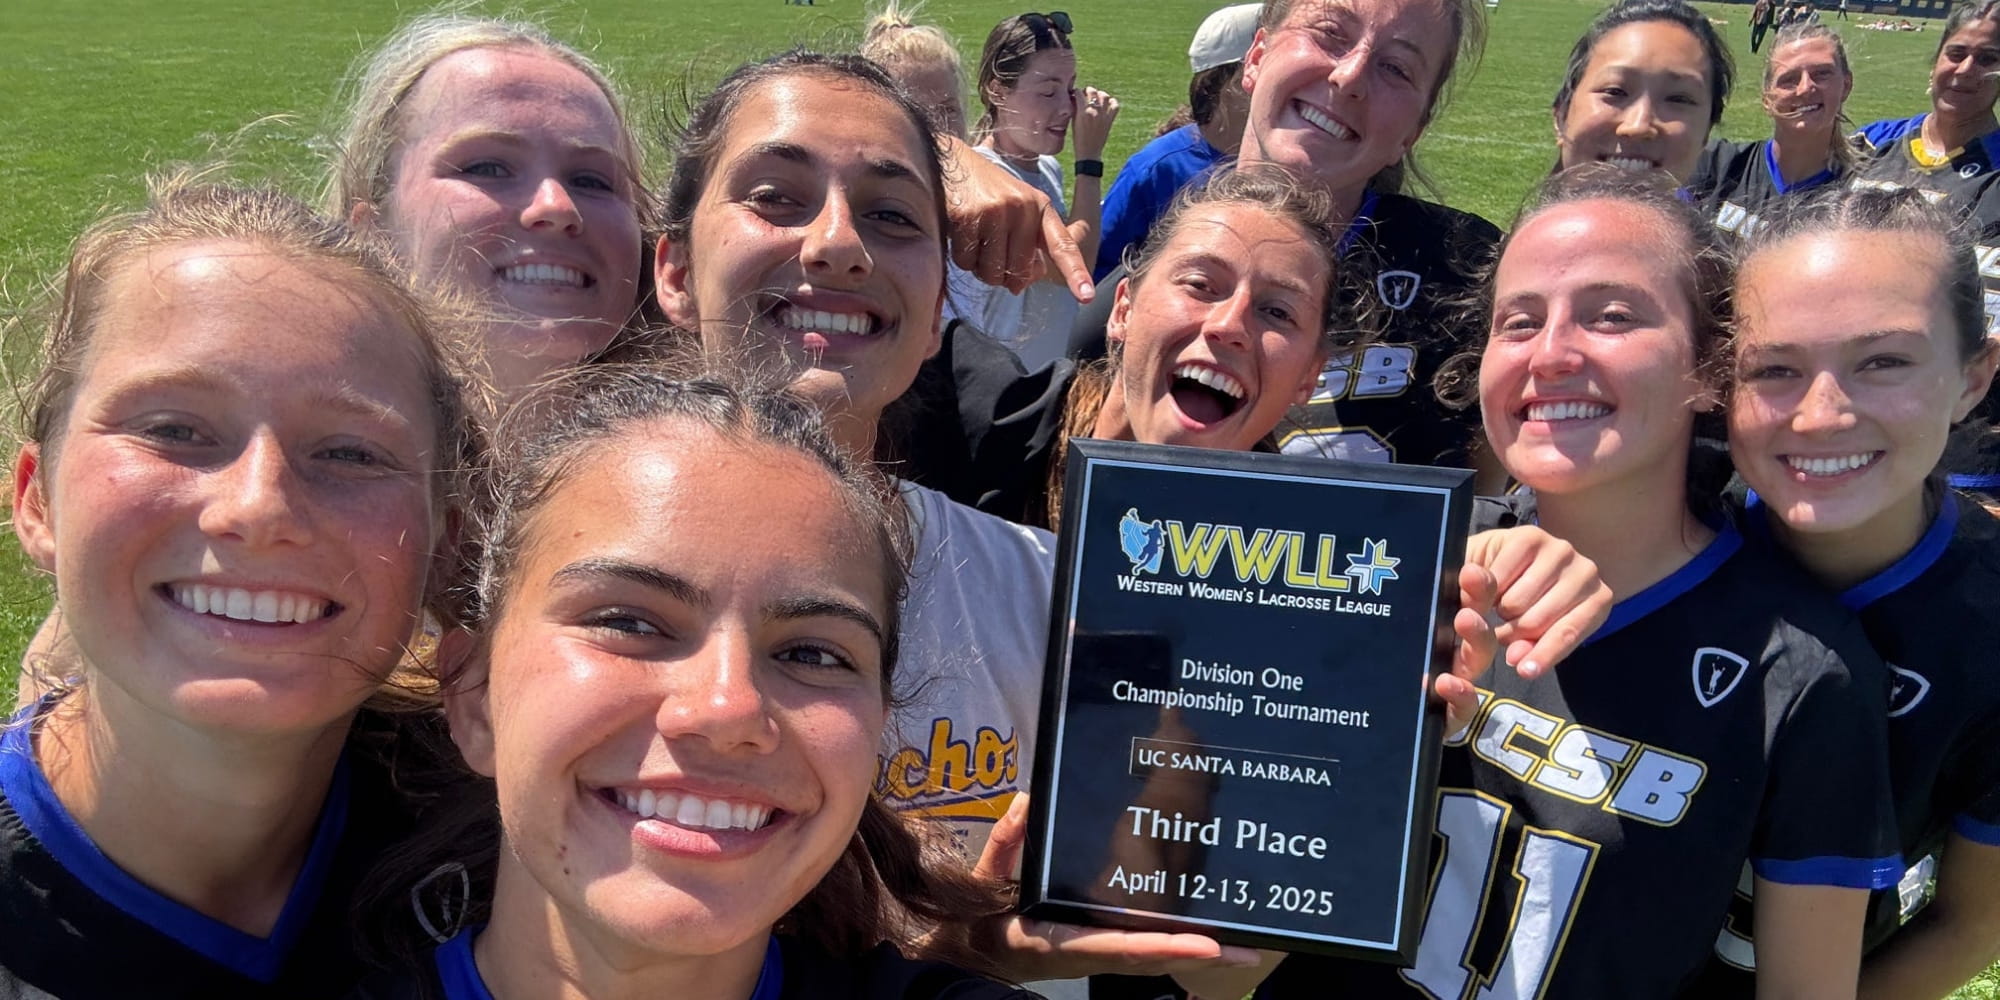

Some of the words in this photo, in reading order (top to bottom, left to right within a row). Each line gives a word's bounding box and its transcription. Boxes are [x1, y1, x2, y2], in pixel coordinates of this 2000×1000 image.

[1166, 520, 1350, 591] WWLL
[1181, 659, 1254, 687] Division
[1261, 668, 1303, 691] One
[1112, 681, 1244, 716] Championship
[1253, 696, 1370, 728] Tournament
[874, 717, 1019, 799] chos
[1138, 748, 1166, 766] UC
[1171, 752, 1235, 775] SANTA
[1242, 760, 1331, 787] BARBARA
[1443, 687, 1708, 828] CSB
[1127, 806, 1220, 846] Third
[1236, 820, 1327, 859] Place
[1108, 865, 1166, 895] April
[1178, 874, 1256, 910] 12-13,
[1268, 885, 1333, 915] 2025
[1400, 788, 1602, 1000] 11
